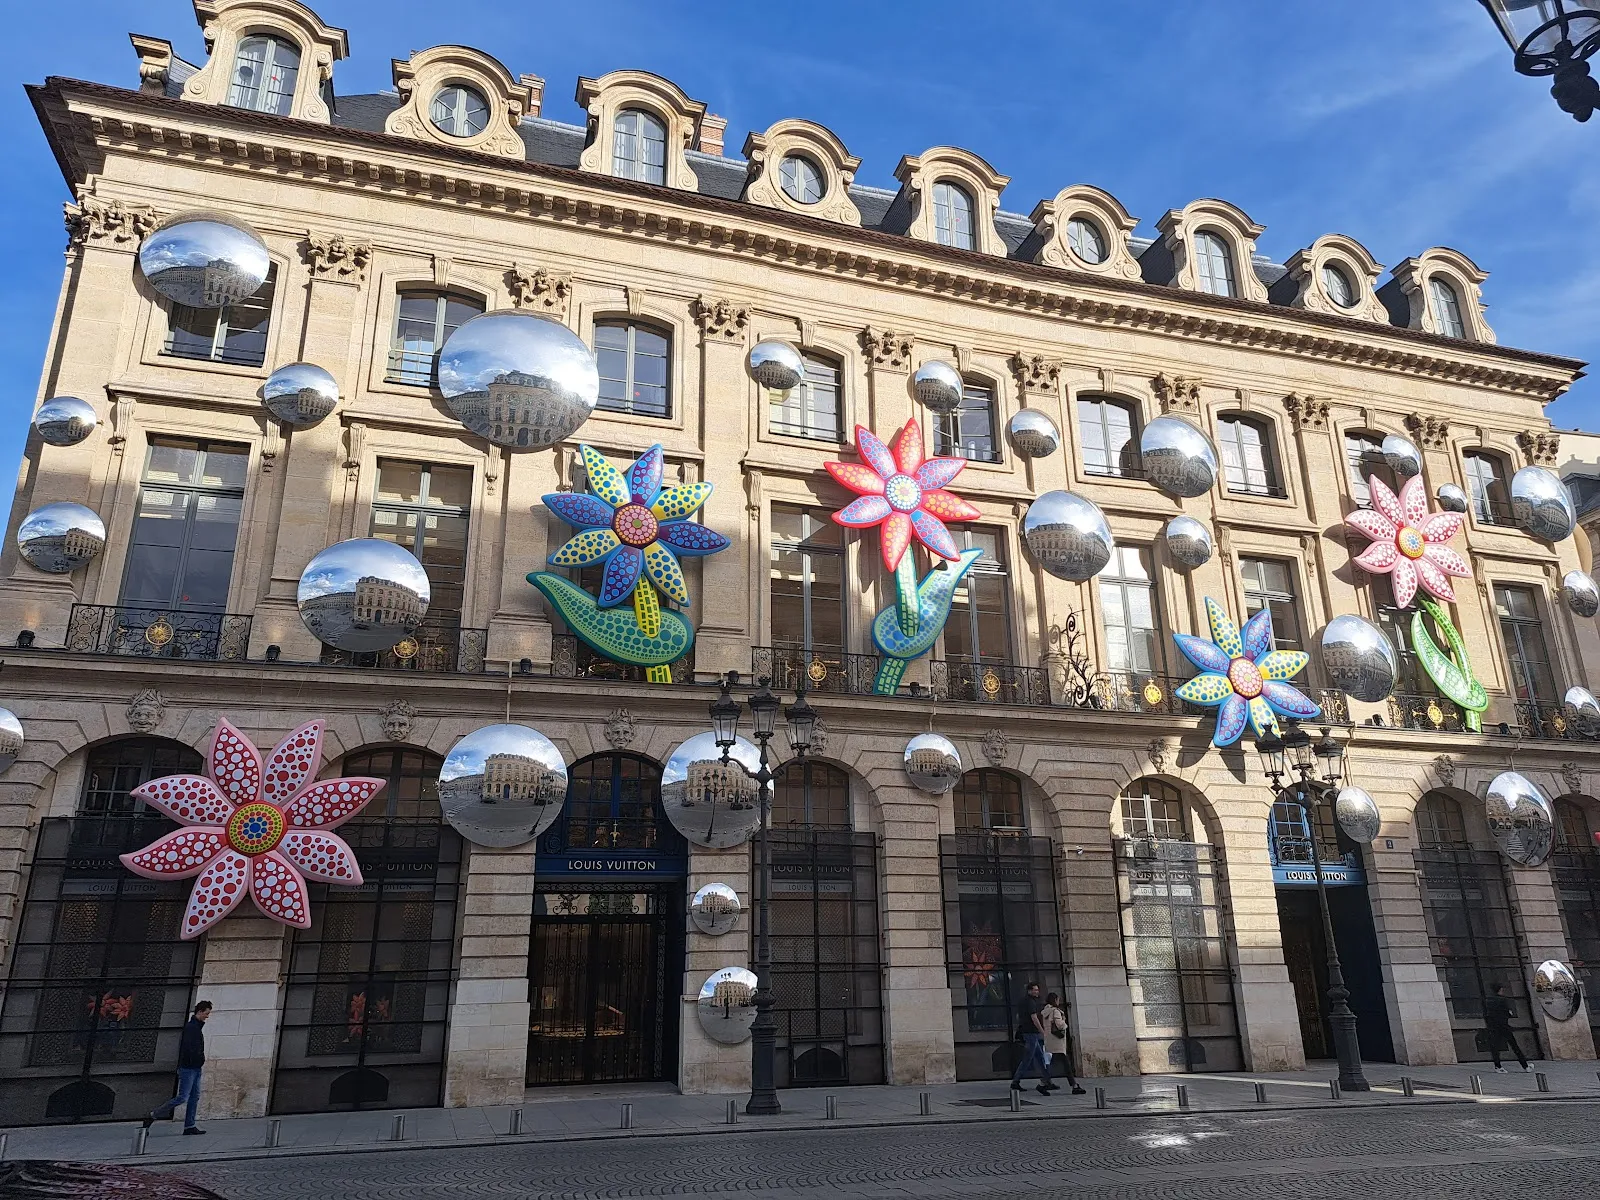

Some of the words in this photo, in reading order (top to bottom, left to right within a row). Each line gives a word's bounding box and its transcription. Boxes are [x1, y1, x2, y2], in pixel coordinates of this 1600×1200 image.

[387, 863, 433, 871] UITTON
[568, 860, 602, 870] LOUIS
[607, 860, 656, 871] VUITTON
[773, 865, 803, 873] LOUIS
[1287, 871, 1311, 880] LOUIS
[88, 884, 115, 892] LOUIS
[123, 884, 157, 892] UITTON
